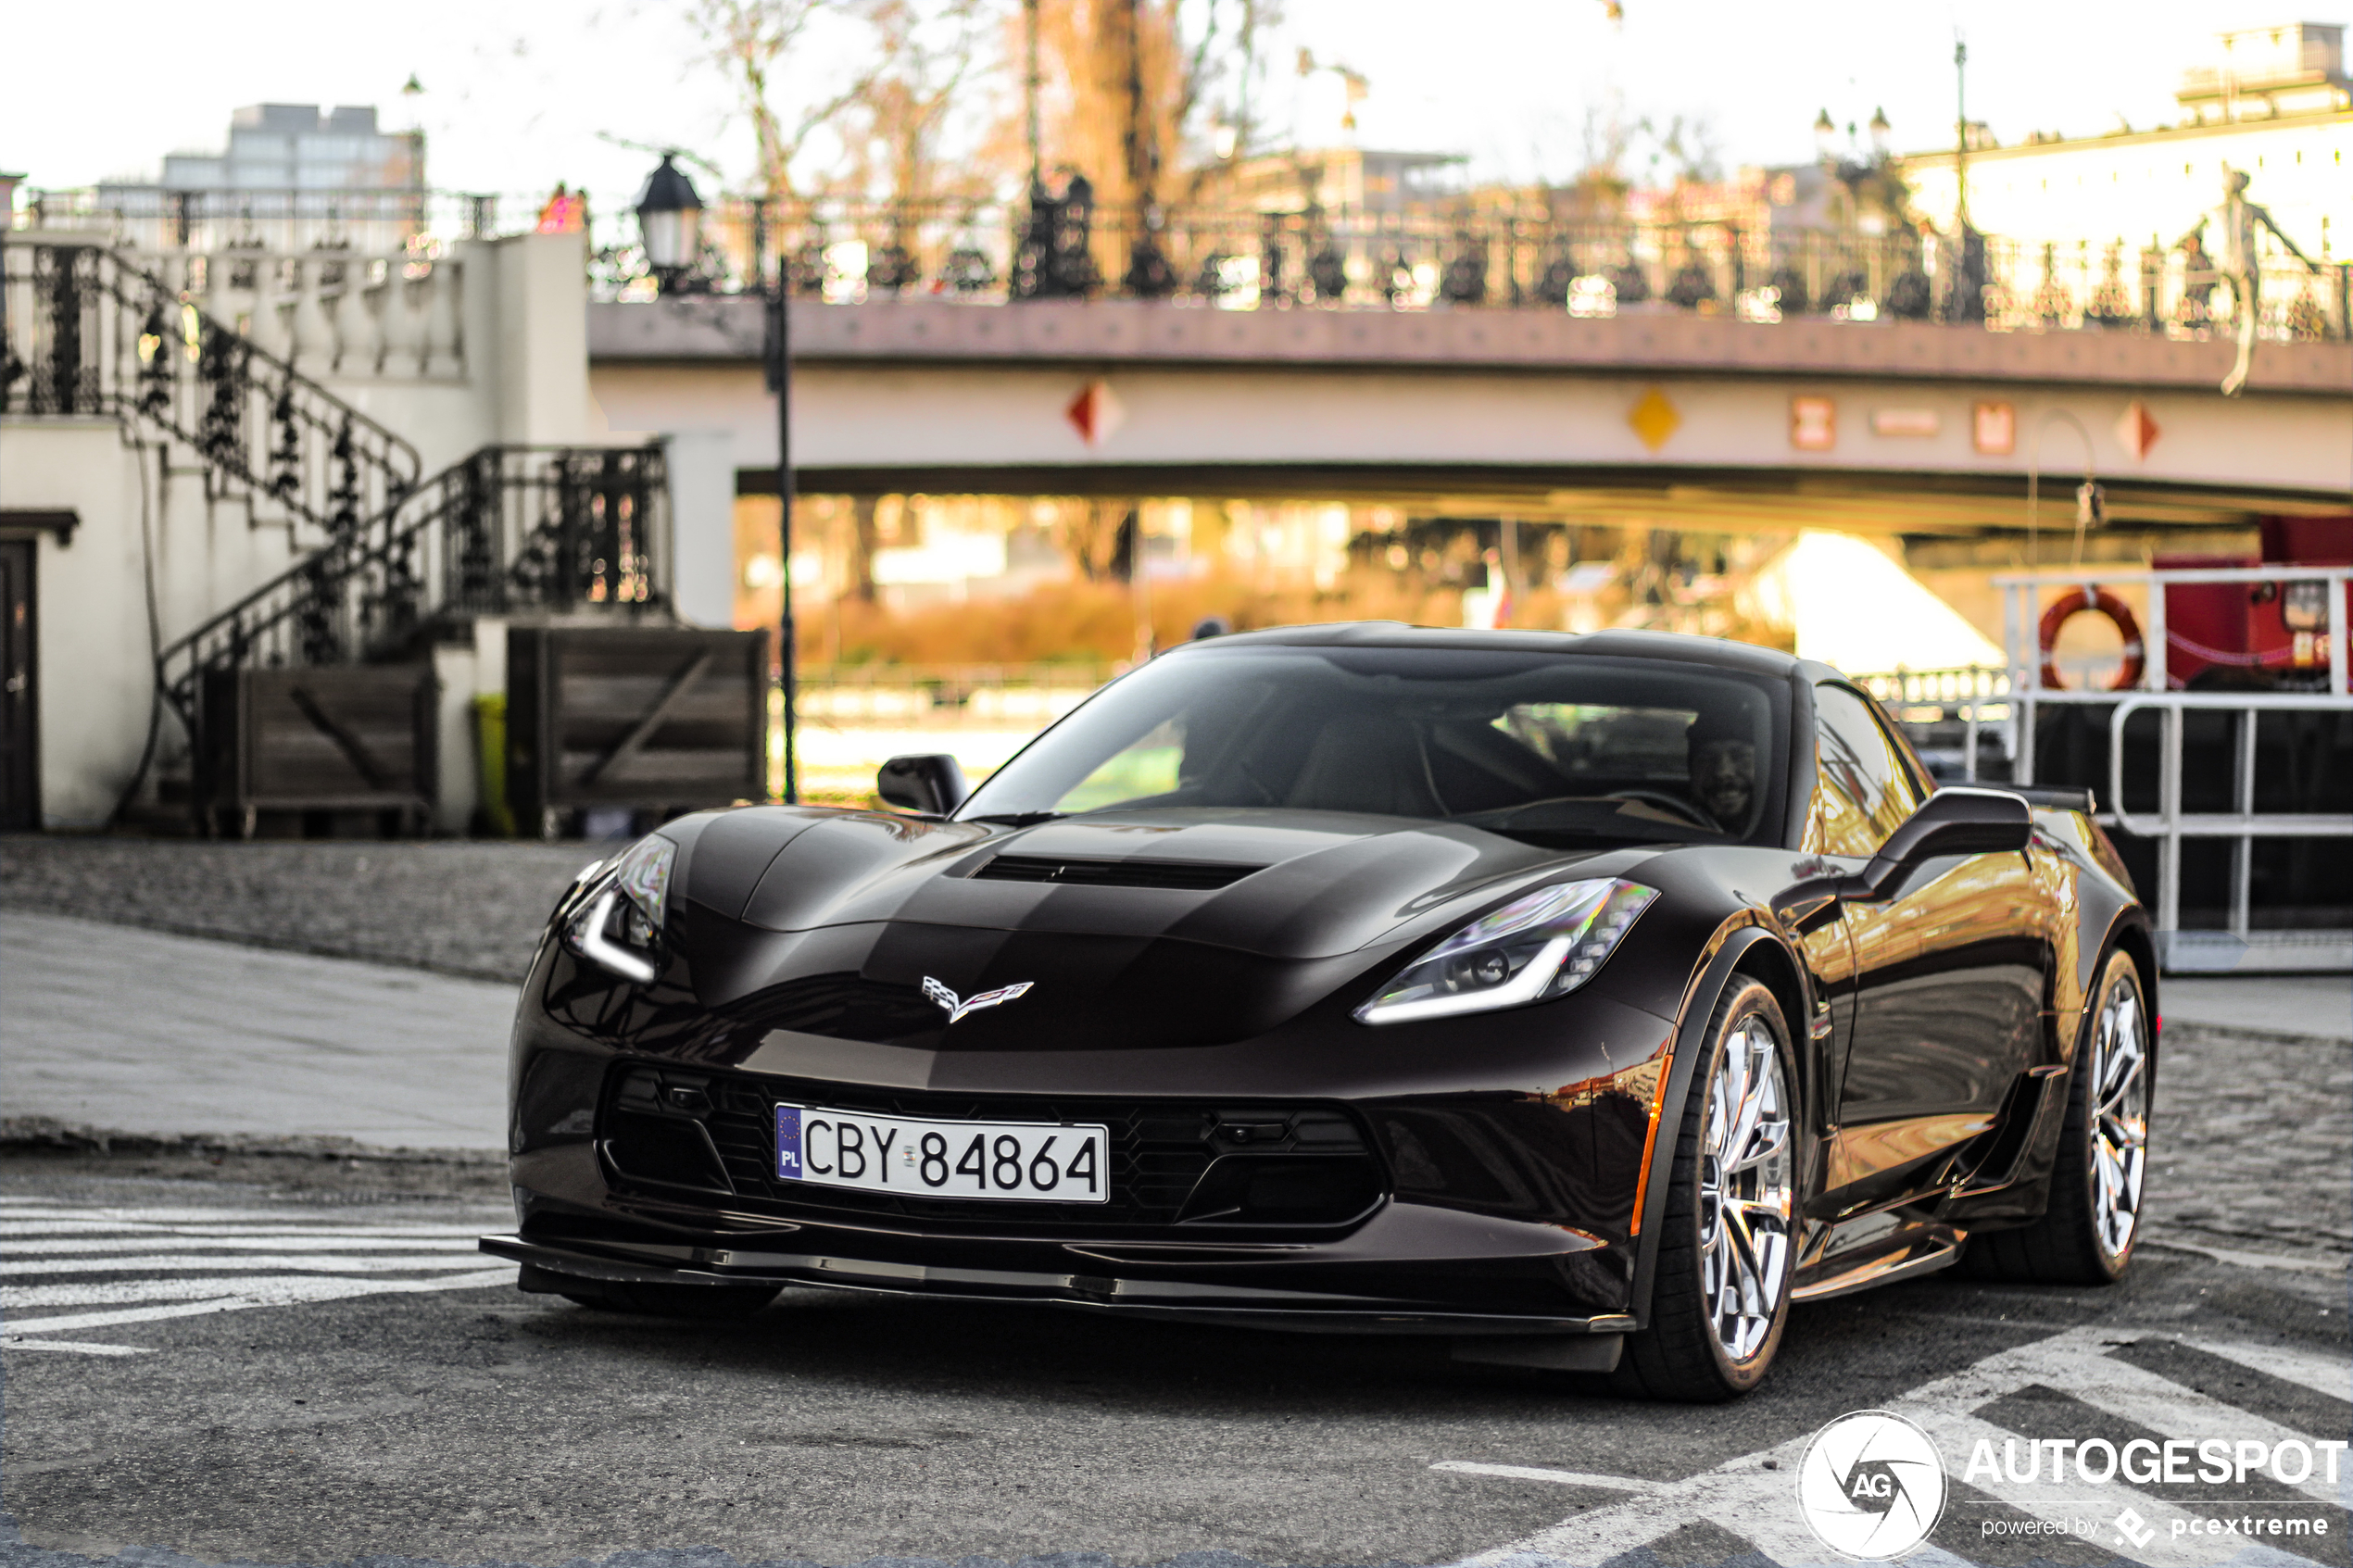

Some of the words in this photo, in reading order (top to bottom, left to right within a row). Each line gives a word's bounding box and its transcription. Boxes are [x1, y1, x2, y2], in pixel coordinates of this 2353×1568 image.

[782, 1150, 799, 1168] PL
[805, 1119, 898, 1183] CBY
[920, 1131, 1097, 1193] 84864
